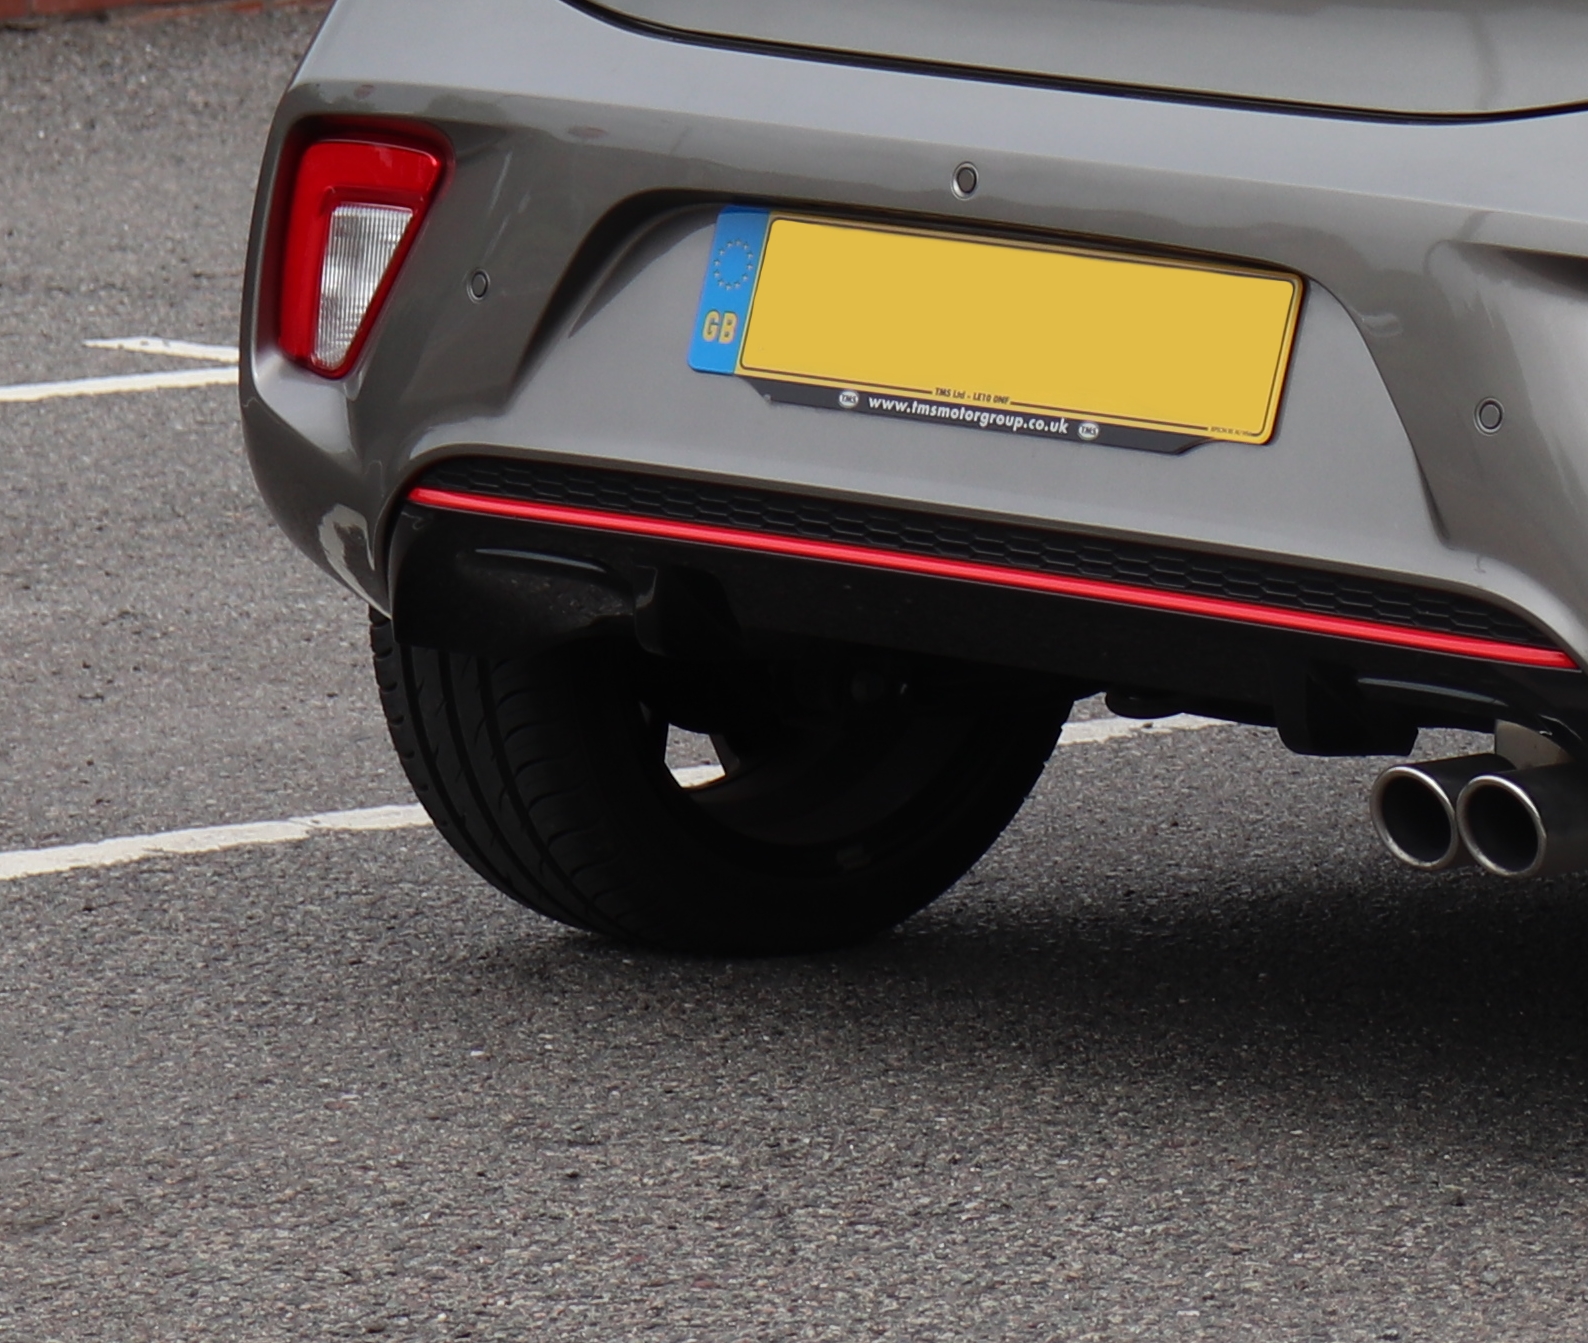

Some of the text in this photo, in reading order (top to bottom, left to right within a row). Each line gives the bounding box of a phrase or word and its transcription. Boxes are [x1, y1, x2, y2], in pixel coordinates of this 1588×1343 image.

[702, 309, 737, 344] GB
[839, 392, 859, 405] TMS
[934, 387, 952, 398] TMS
[868, 395, 1069, 434] www.tmsmotorgroup.co.uk
[1079, 424, 1099, 437] TMS
